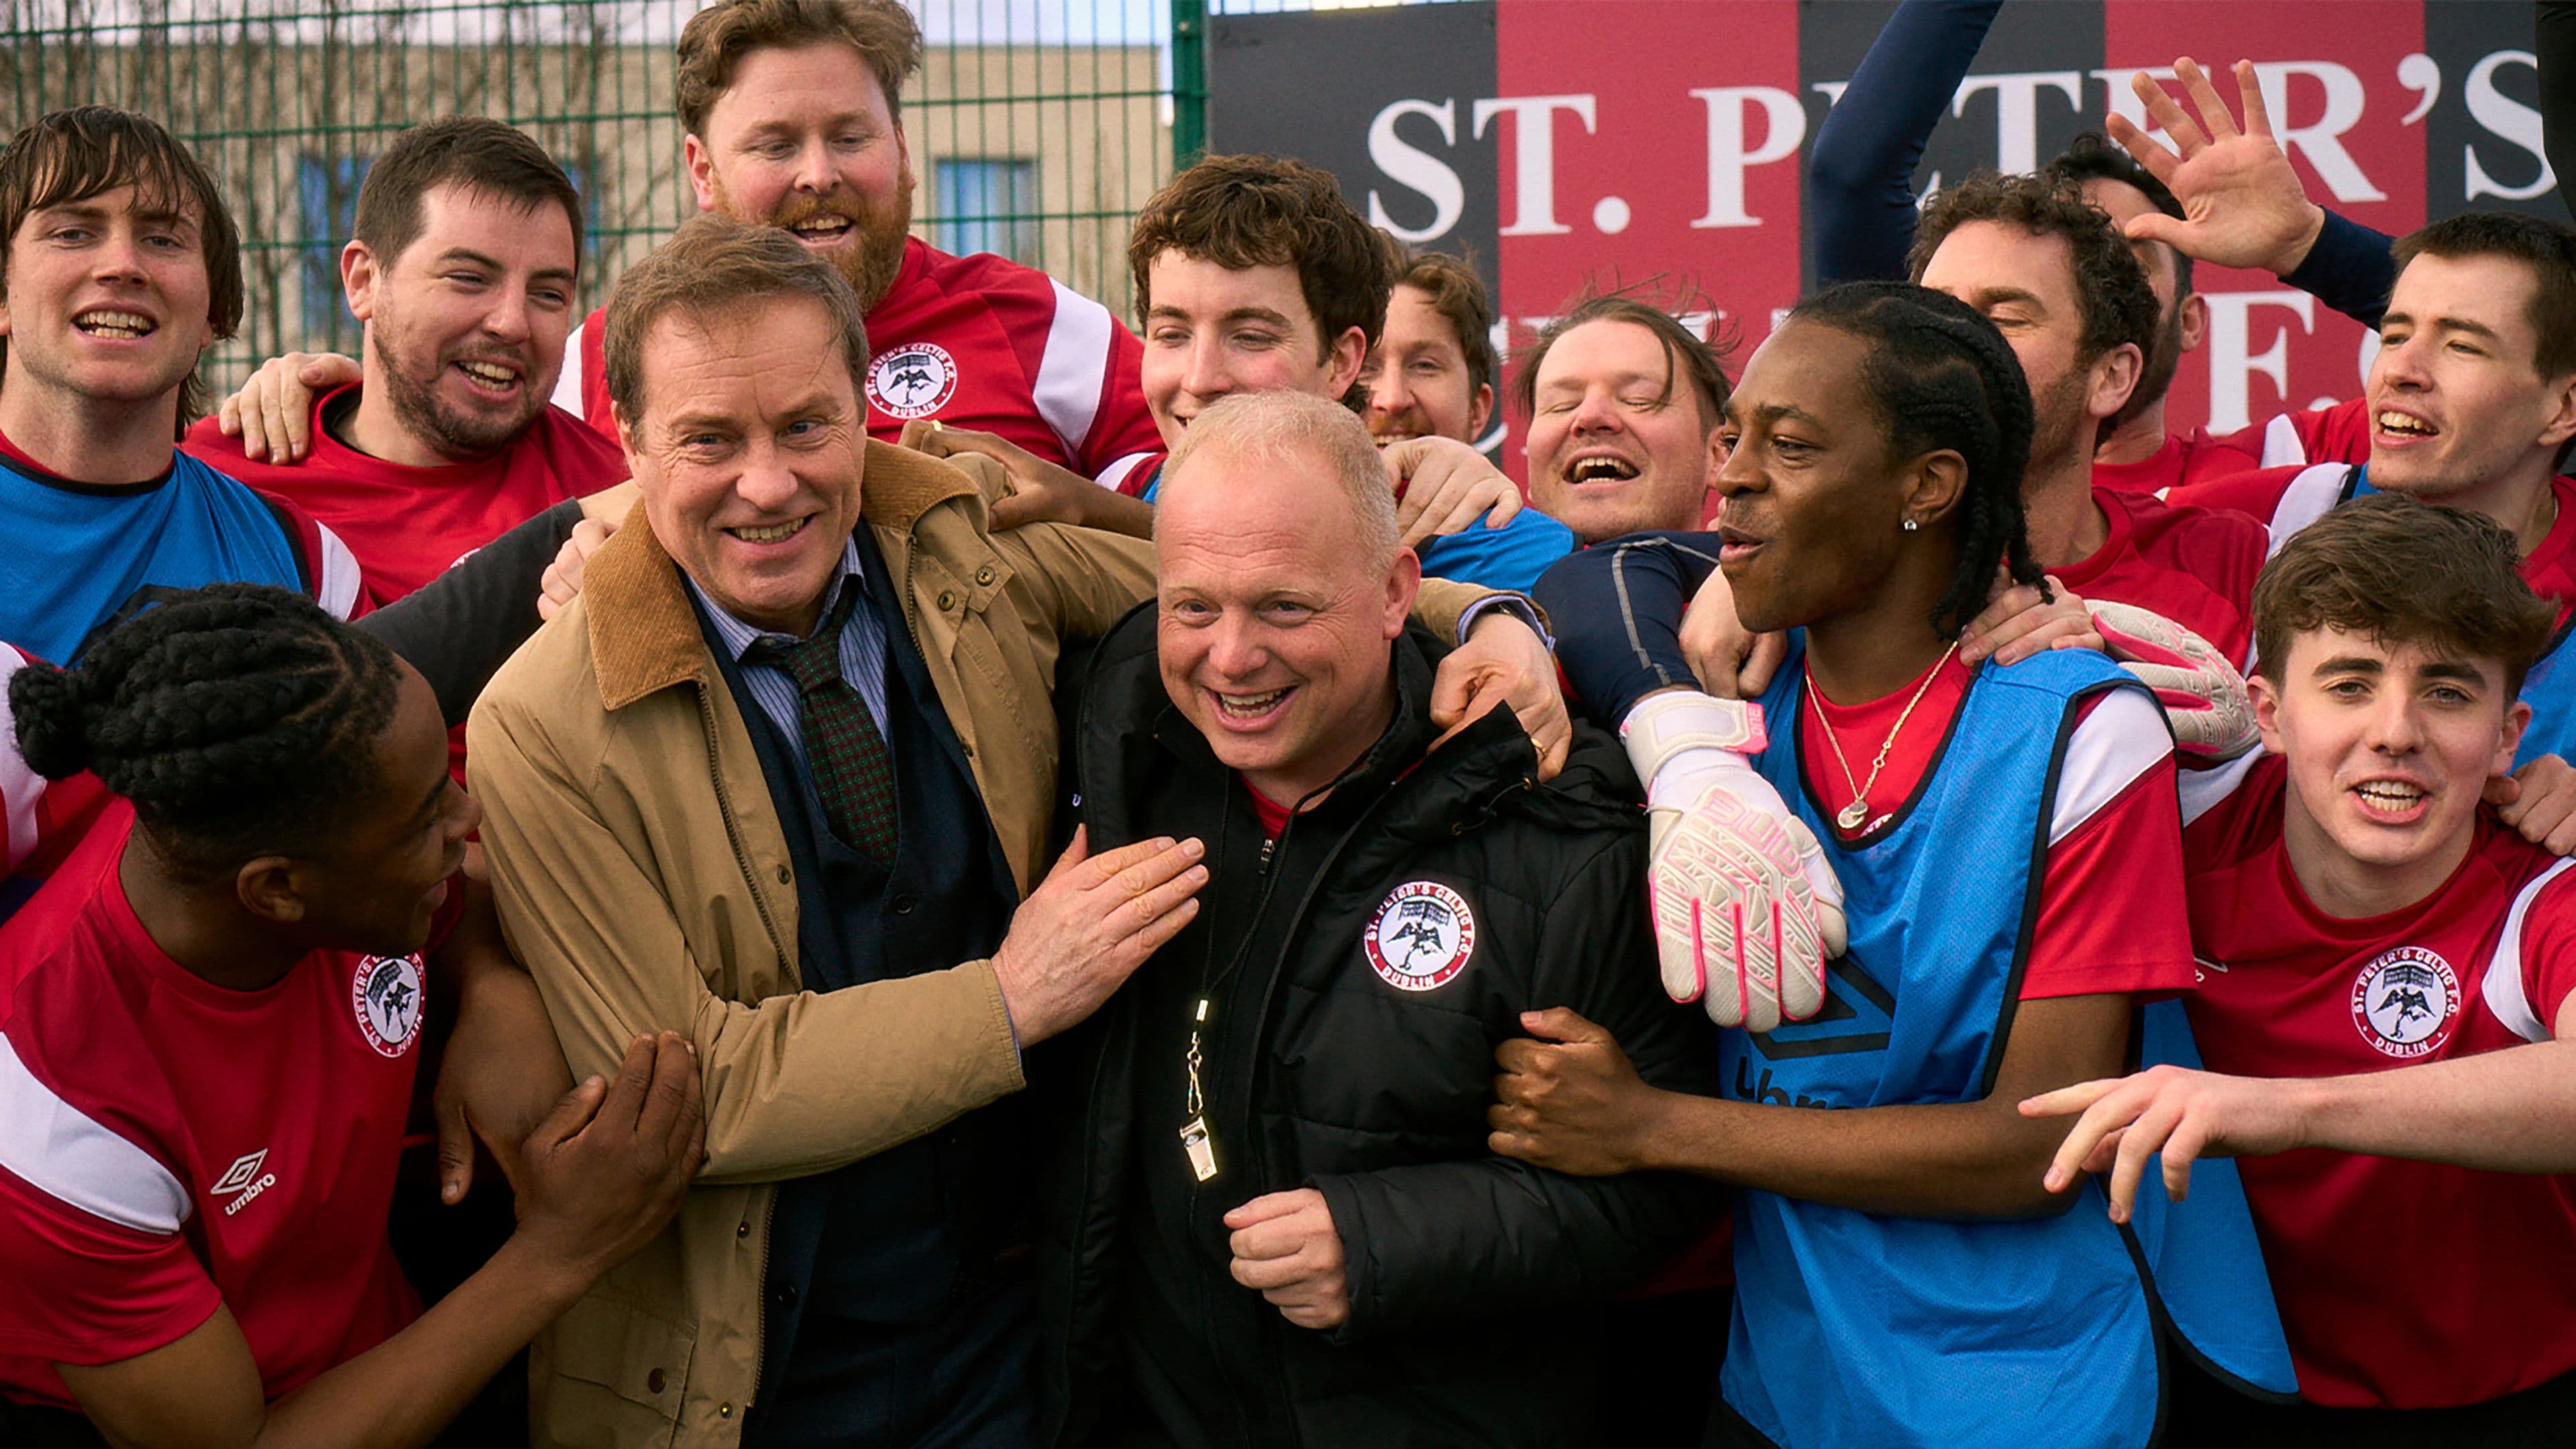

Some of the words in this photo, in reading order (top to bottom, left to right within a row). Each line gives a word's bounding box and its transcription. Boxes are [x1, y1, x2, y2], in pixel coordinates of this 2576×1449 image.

[1367, 93, 1630, 242] ST.
[1689, 50, 2557, 229] PTR'S
[891, 400, 937, 417] DUBLIN
[1435, 888, 1470, 926] CELTIC
[1382, 967, 1435, 988] DUBLIN
[2359, 949, 2411, 987] PETER'S
[2415, 951, 2454, 985] CELTIC
[2375, 1037, 2429, 1056] DUBLIN
[225, 1173, 276, 1216] umbro
